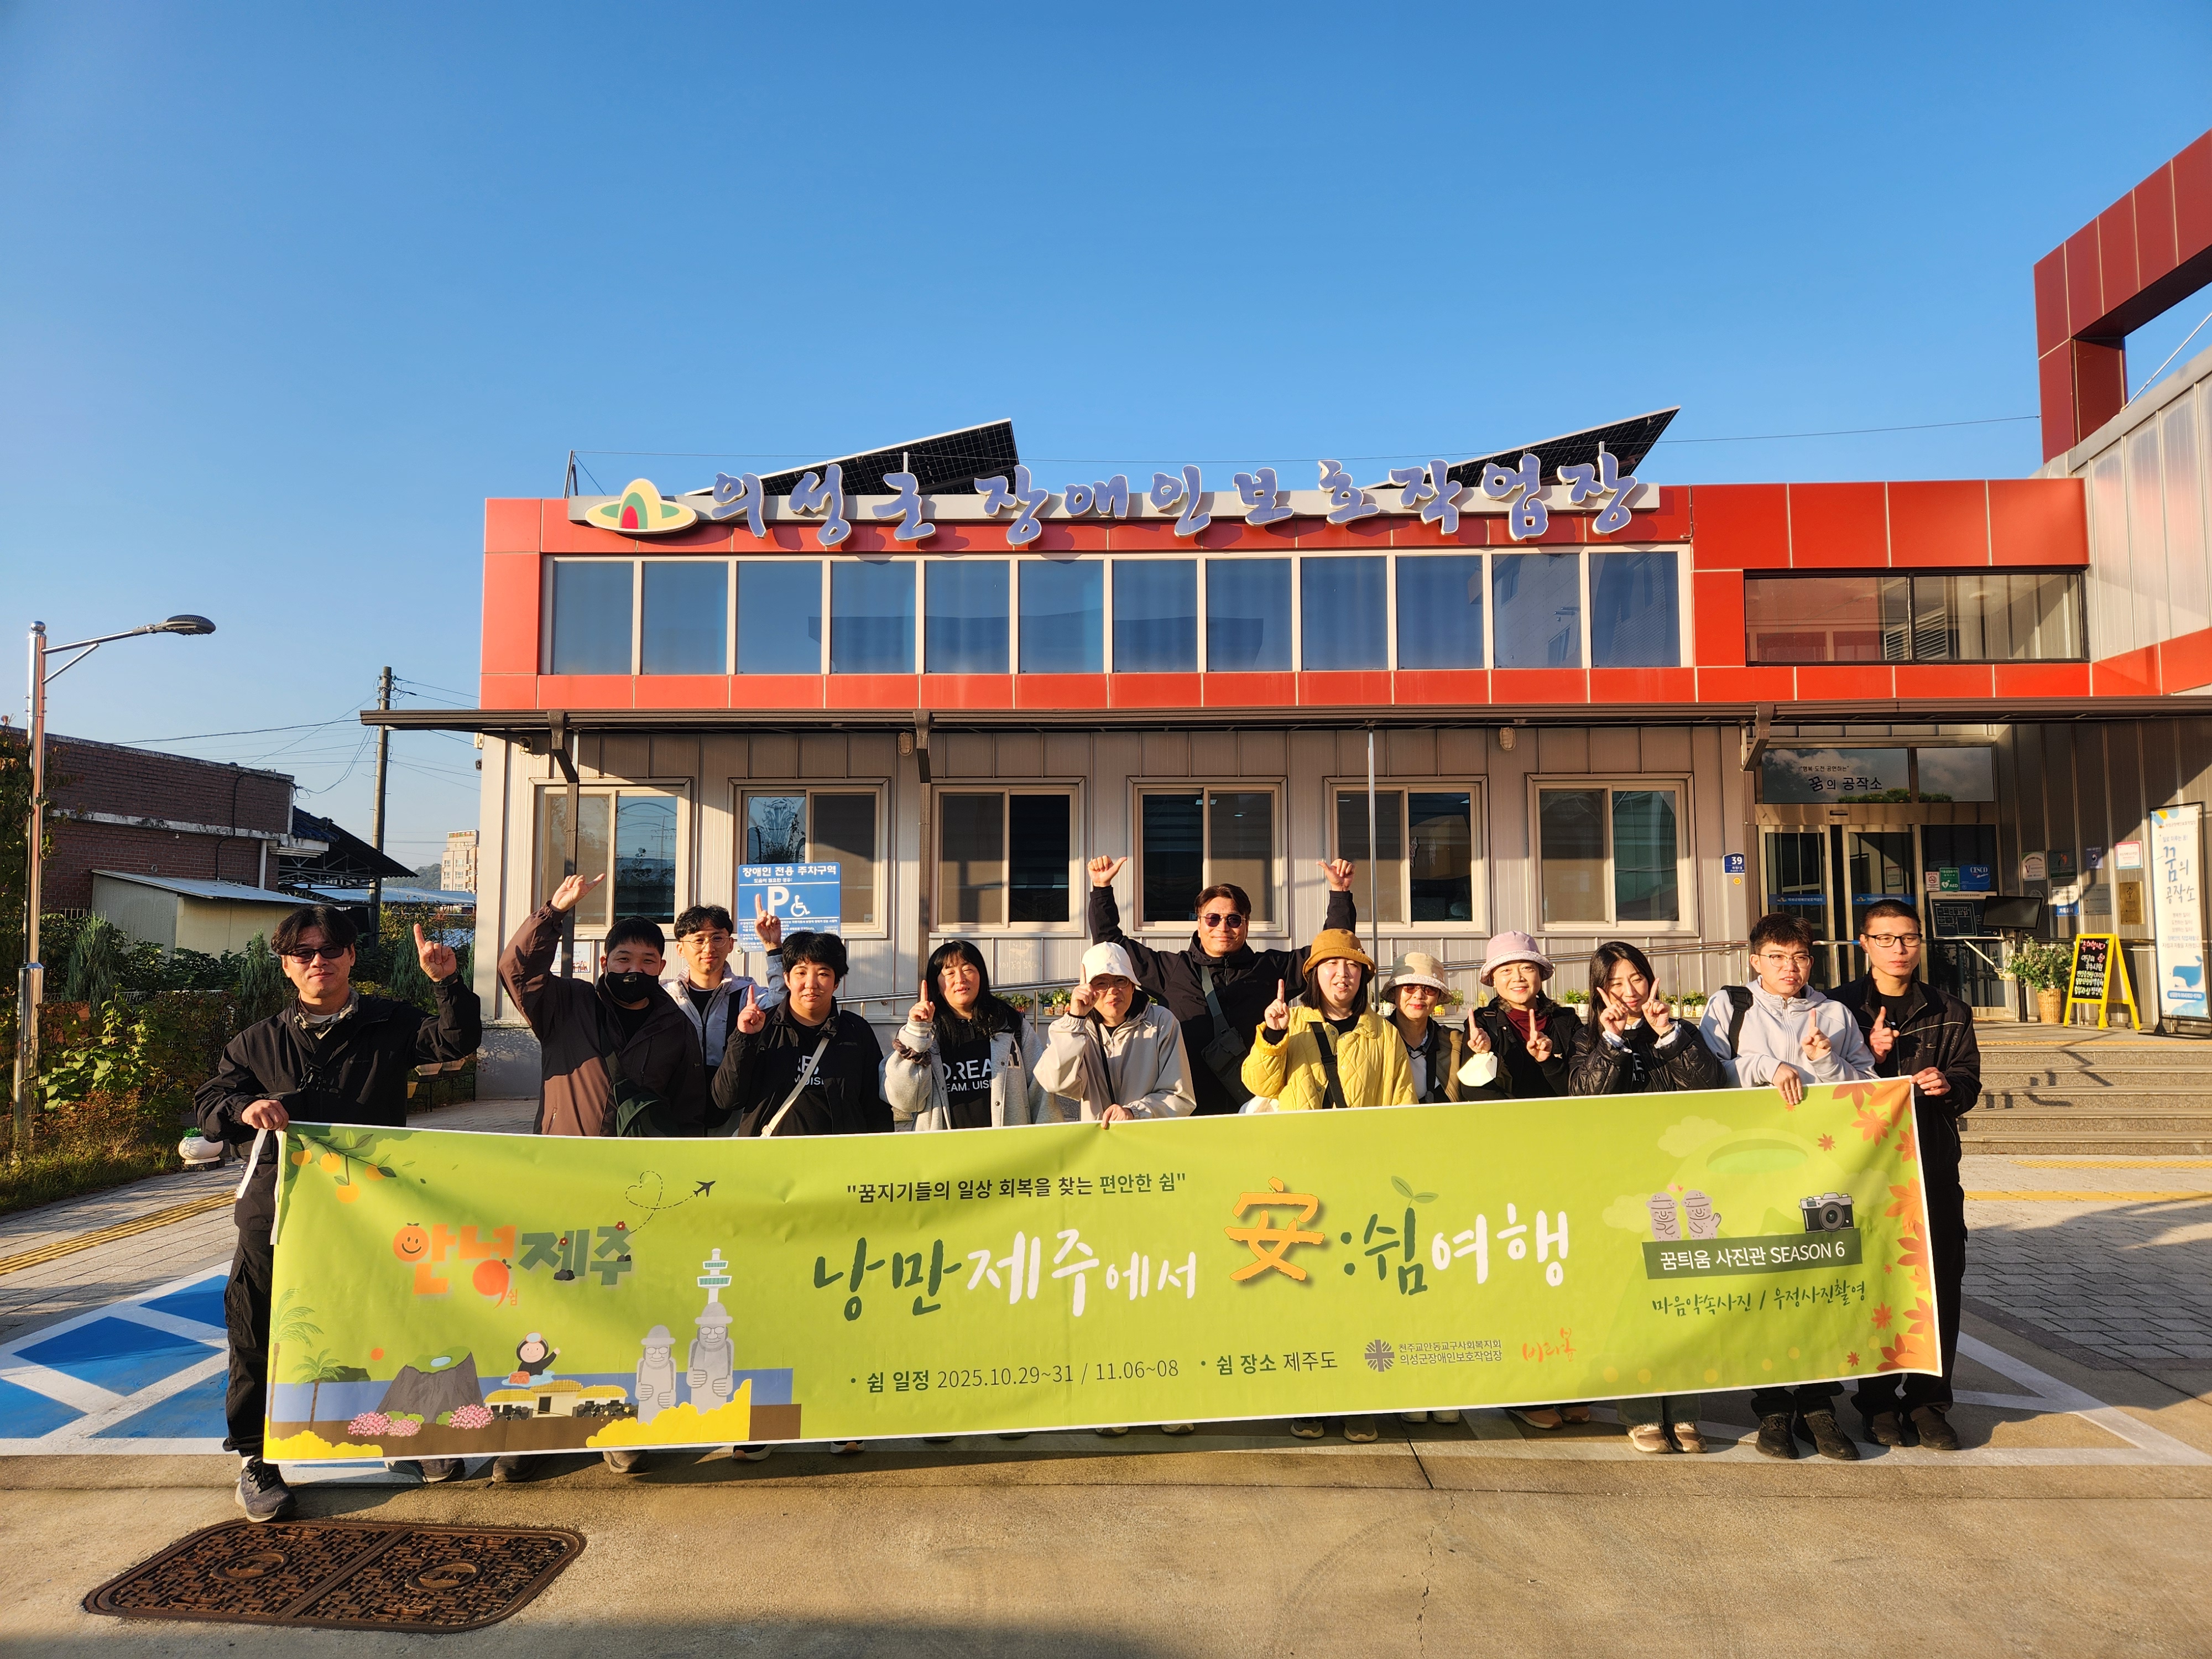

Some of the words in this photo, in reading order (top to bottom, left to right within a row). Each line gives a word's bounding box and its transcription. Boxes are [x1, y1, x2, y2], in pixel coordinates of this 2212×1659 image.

[712, 463, 936, 546] 의성군
[974, 452, 1637, 546] 장애인보호작업장
[1808, 776, 1836, 792] 꿈의
[1842, 776, 1882, 790] 공작소
[742, 867, 771, 878] 장애인
[775, 866, 794, 877] 전용
[797, 865, 837, 875] 주차구역
[1731, 856, 1743, 865] 39
[2163, 846, 2189, 883] 꿈의
[768, 886, 790, 916] P
[2166, 883, 2195, 904] 공작소
[847, 1180, 951, 1203] "꿈지기들의
[957, 1178, 993, 1200] 일상
[998, 1177, 1051, 1199] 회복을
[1057, 1176, 1093, 1196] 찾는
[1099, 1172, 1152, 1195] 편안한
[1159, 1172, 1186, 1193] 쉼"
[813, 1237, 962, 1321] 낭만
[967, 1229, 1197, 1317] 제주에서
[1431, 1203, 1568, 1287] 여행
[1660, 1250, 1711, 1271] 꿈틔움
[1715, 1246, 1766, 1268] 사진관
[1770, 1243, 1832, 1264] SEASON
[1835, 1241, 1845, 1258] 6
[1652, 1292, 1751, 1317] 마음약속사진
[1773, 1279, 1865, 1311] 우정사진촬영
[1398, 1339, 1502, 1353] 천주교안동교구사회복지회
[1400, 1350, 1503, 1366] 의성군장애인보호작업장
[867, 1371, 885, 1392] 쉼
[893, 1370, 930, 1392] 일정
[937, 1365, 1074, 1389] 2025.10.29~31
[1096, 1359, 1179, 1381] 11.06~08
[1216, 1355, 1234, 1375] 쉼
[1239, 1354, 1277, 1374] 장소
[1283, 1351, 1338, 1373] 제주도
